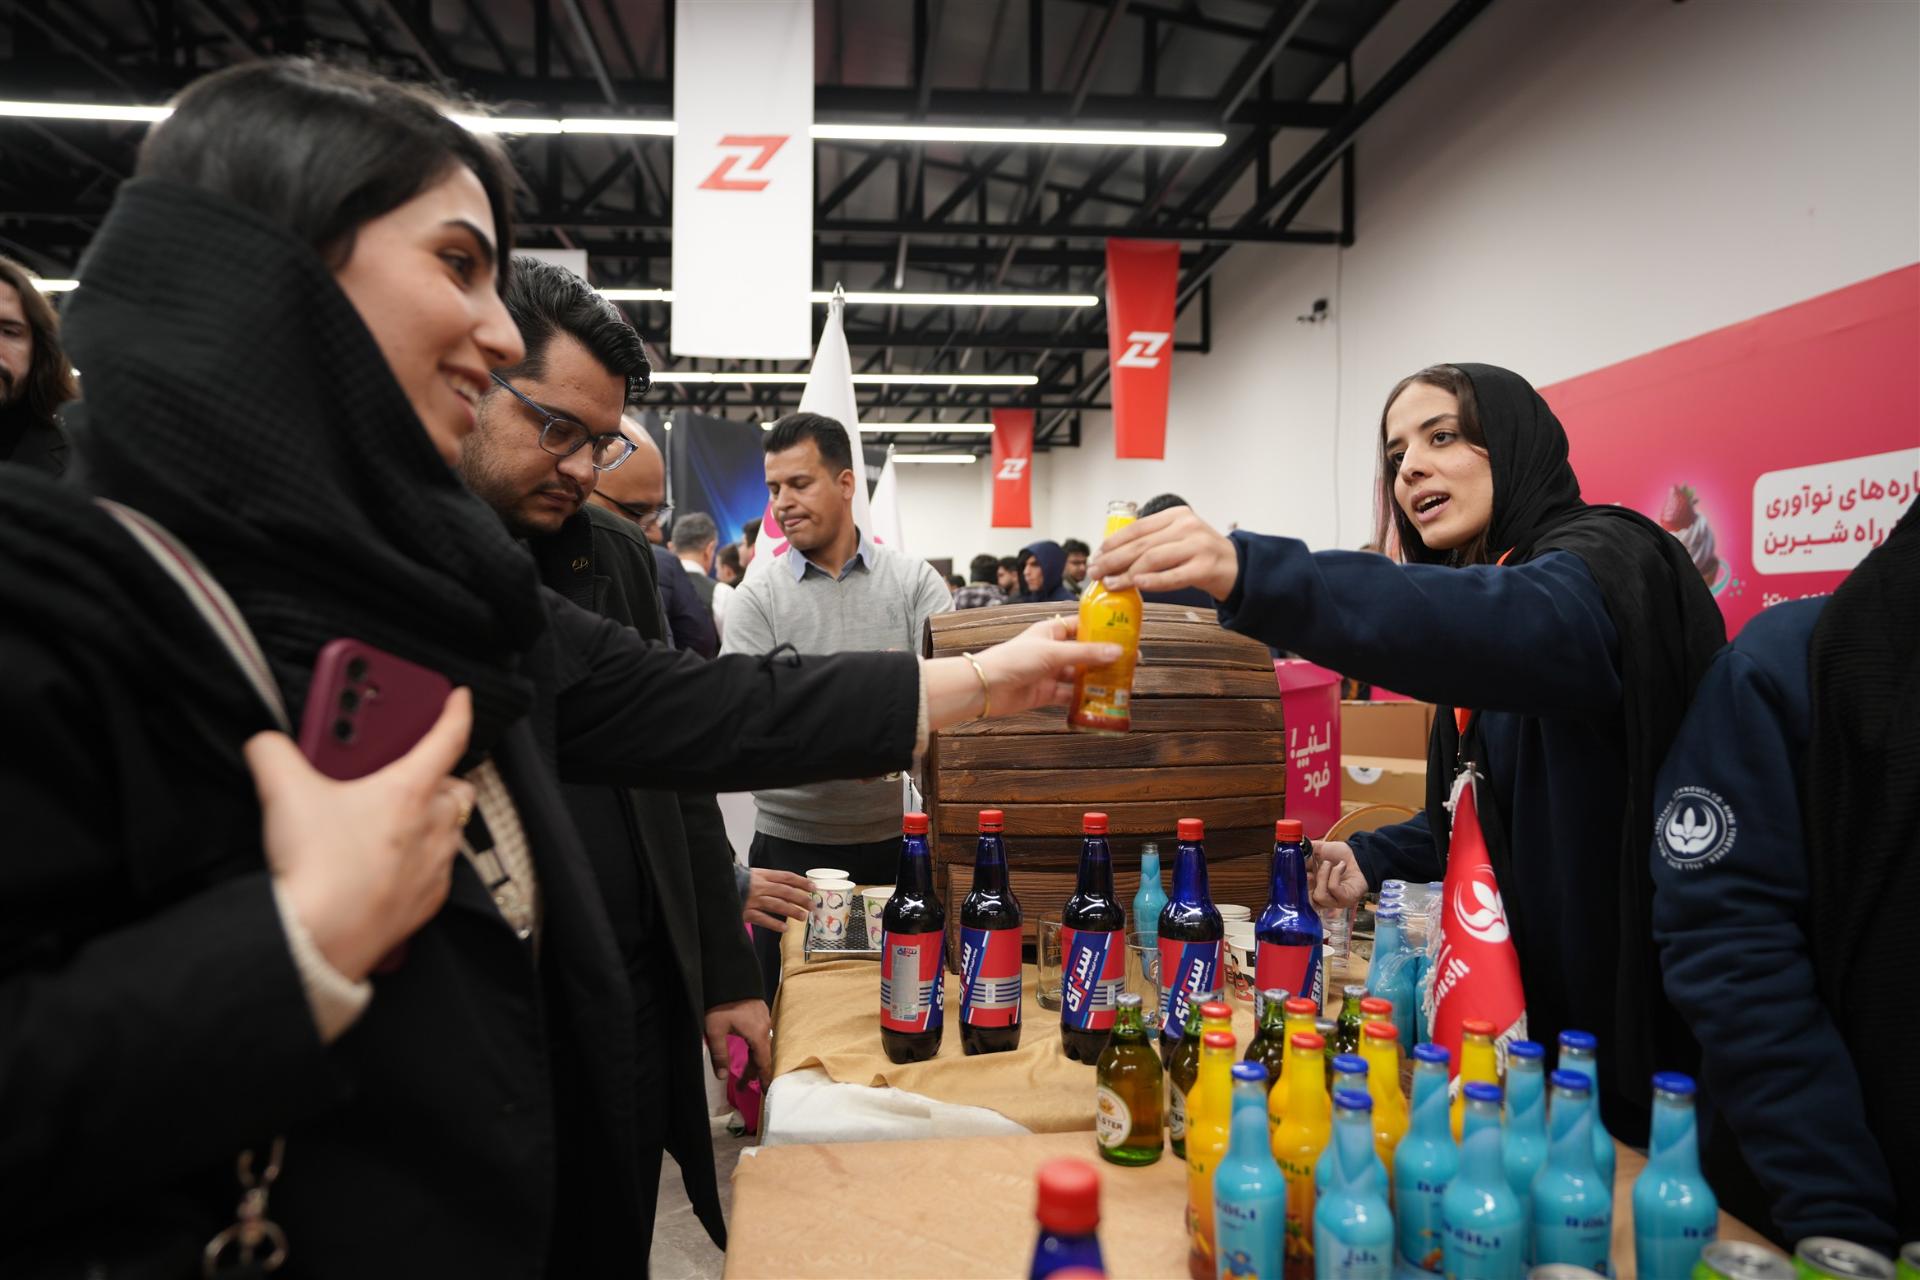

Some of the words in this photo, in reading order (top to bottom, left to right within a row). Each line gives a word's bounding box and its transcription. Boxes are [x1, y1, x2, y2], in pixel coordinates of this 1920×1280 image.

[1766, 484, 1833, 519] نوآوری
[1764, 519, 1849, 555] شیرین
[1303, 761, 1330, 797] فود
